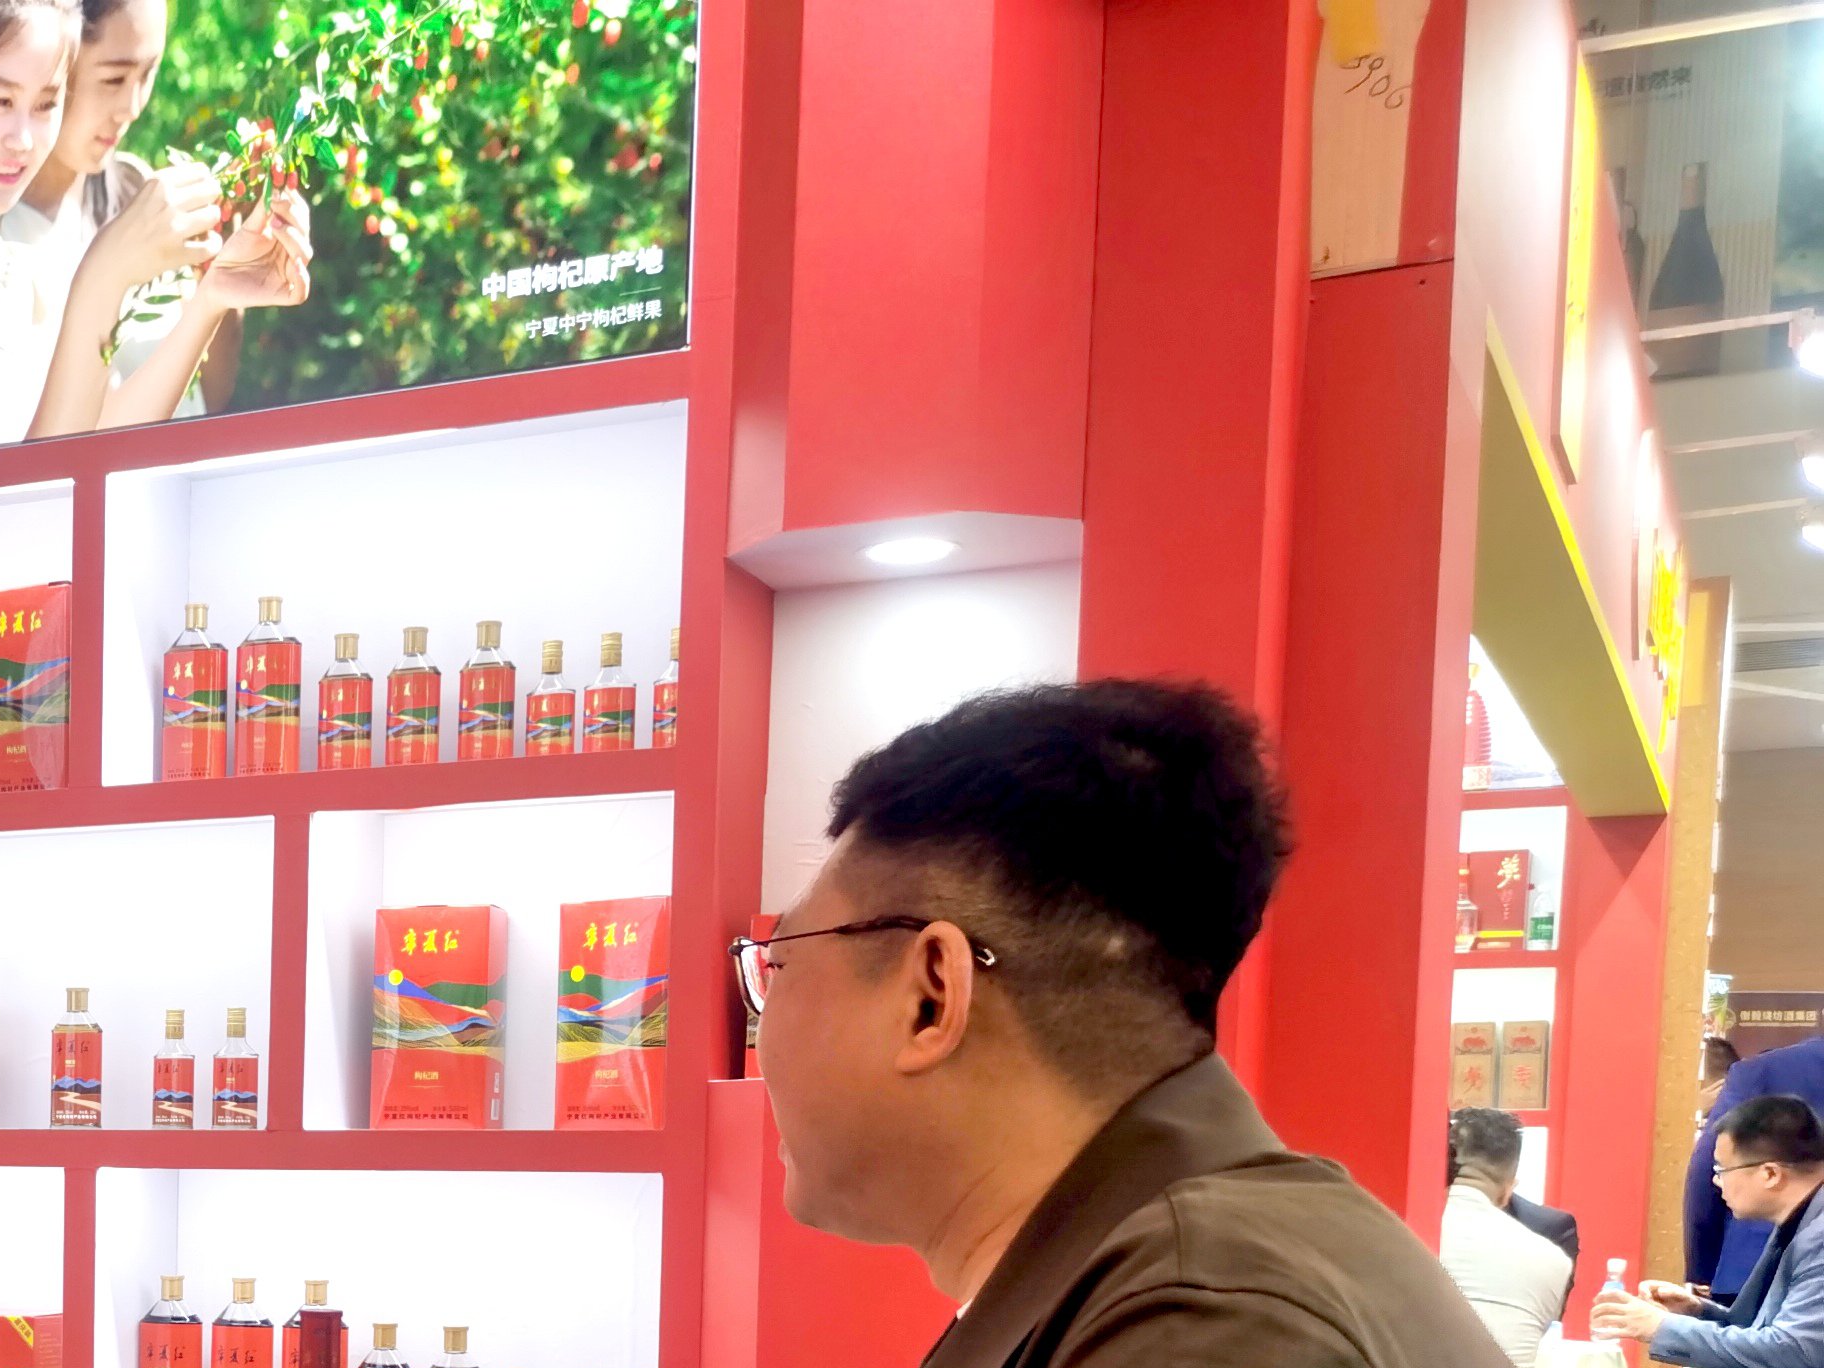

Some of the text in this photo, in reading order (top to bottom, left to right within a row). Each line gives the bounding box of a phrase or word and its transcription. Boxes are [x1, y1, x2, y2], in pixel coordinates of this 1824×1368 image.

[482, 244, 664, 302] 中国枸杞原产地
[525, 299, 662, 339] 宁夏中宁枸杞鲜果
